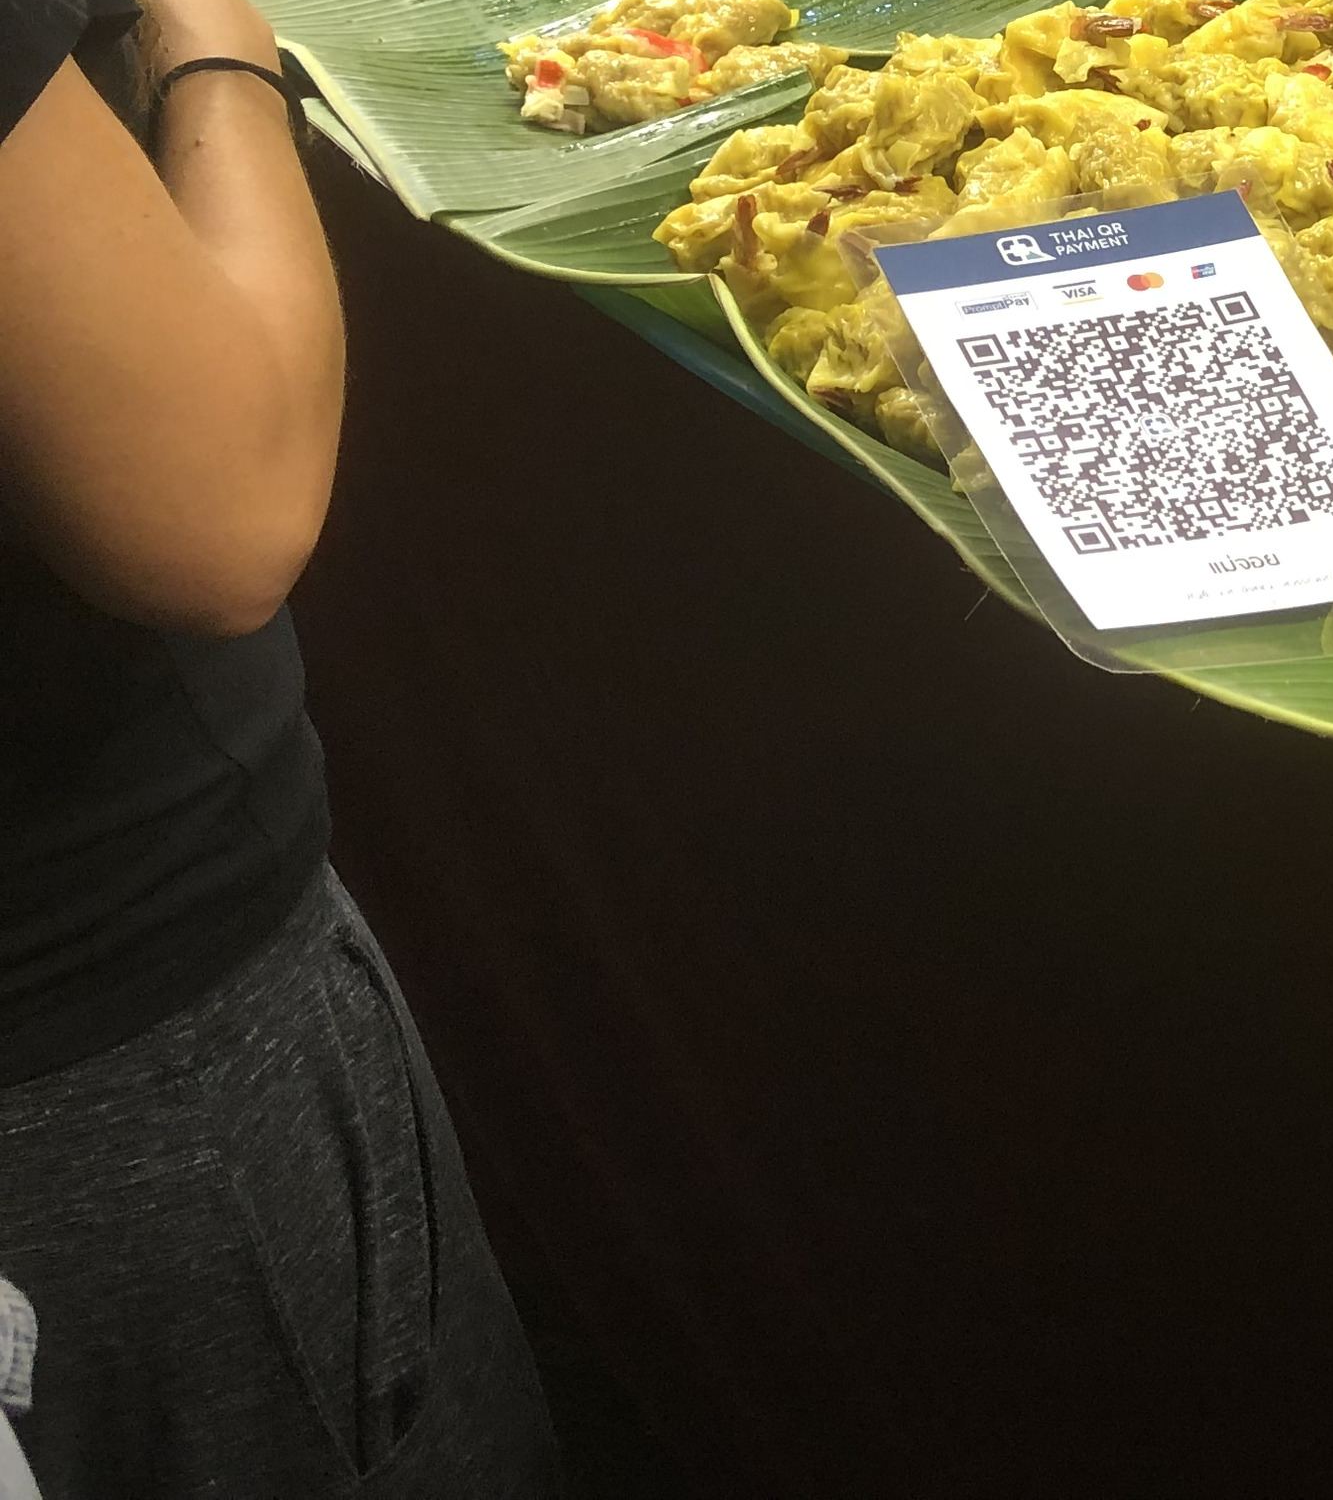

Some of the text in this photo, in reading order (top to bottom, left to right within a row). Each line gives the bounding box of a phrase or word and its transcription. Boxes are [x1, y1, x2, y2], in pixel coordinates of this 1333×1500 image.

[1049, 222, 1126, 245] THAI QR
[1055, 234, 1129, 256] PAYMENT
[1061, 286, 1097, 299] VISA
